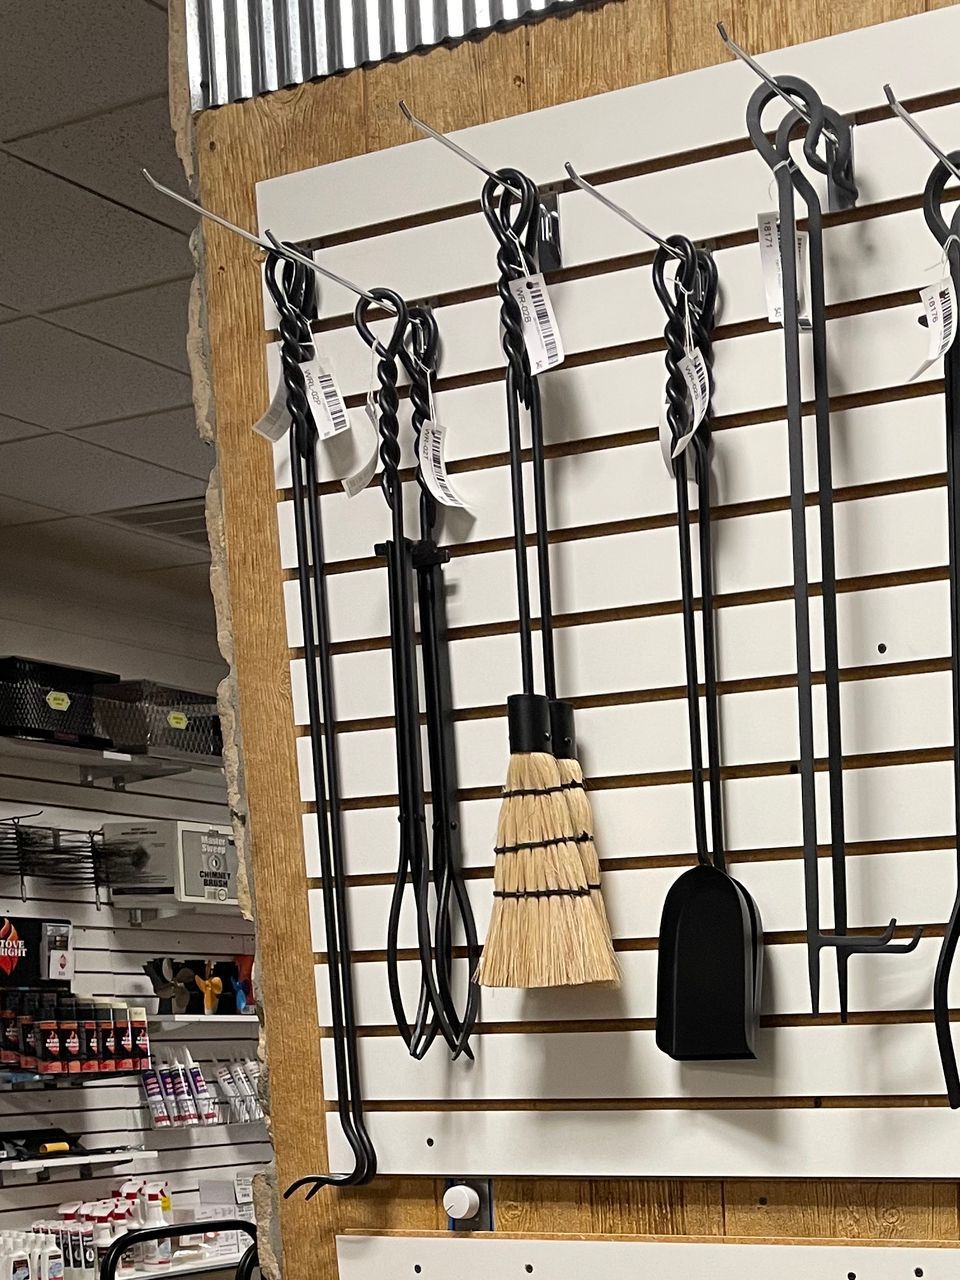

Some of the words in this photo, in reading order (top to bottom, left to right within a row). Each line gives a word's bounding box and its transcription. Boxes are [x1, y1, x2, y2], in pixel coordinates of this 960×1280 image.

[763, 221, 773, 248] 18171
[200, 870, 231, 880] CHIMNEY
[203, 878, 228, 888] BRUSH
[0, 940, 25, 949] TOVE
[0, 948, 27, 957] IGHT
